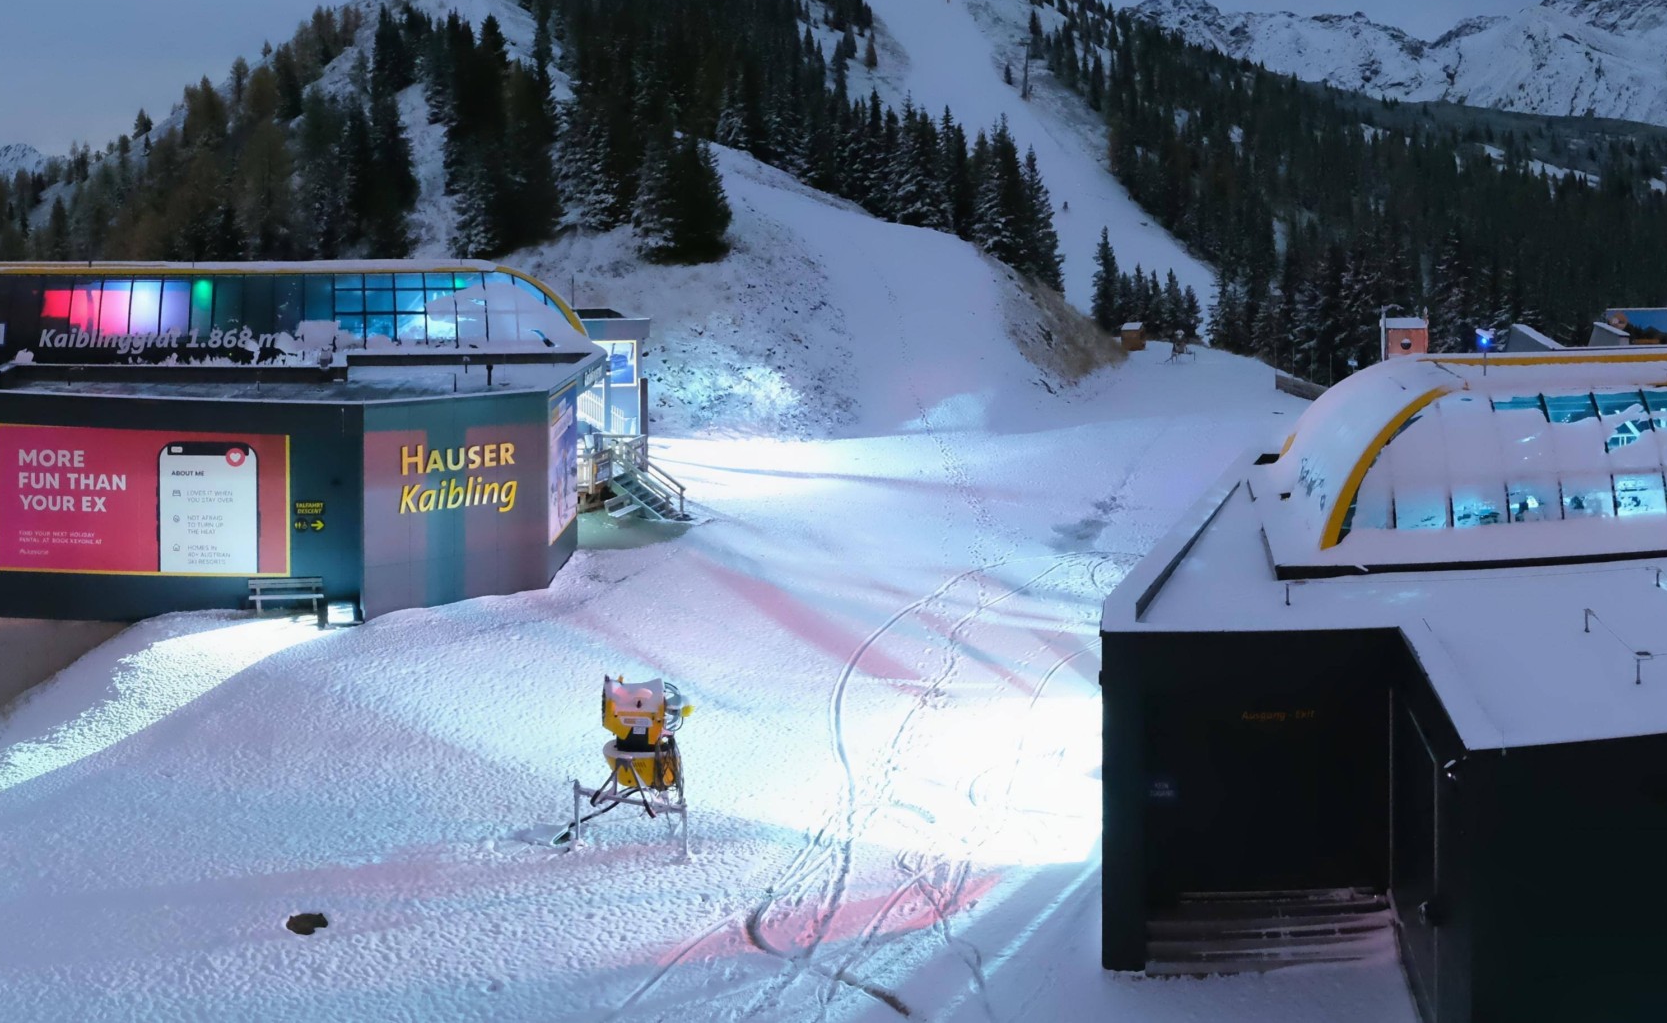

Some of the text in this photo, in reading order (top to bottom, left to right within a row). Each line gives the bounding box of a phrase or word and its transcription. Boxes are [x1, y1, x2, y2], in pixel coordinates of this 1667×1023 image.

[39, 327, 181, 354] Kaiblinggrat
[186, 327, 253, 348] 1.868
[18, 448, 85, 468] MORE
[400, 442, 515, 476] HAUSER
[18, 472, 127, 491] FUN THAN
[19, 494, 107, 512] YOUR EX
[399, 476, 518, 514] Kaibling
[1240, 710, 1286, 722] Ausgang
[1295, 709, 1315, 719] Exit
